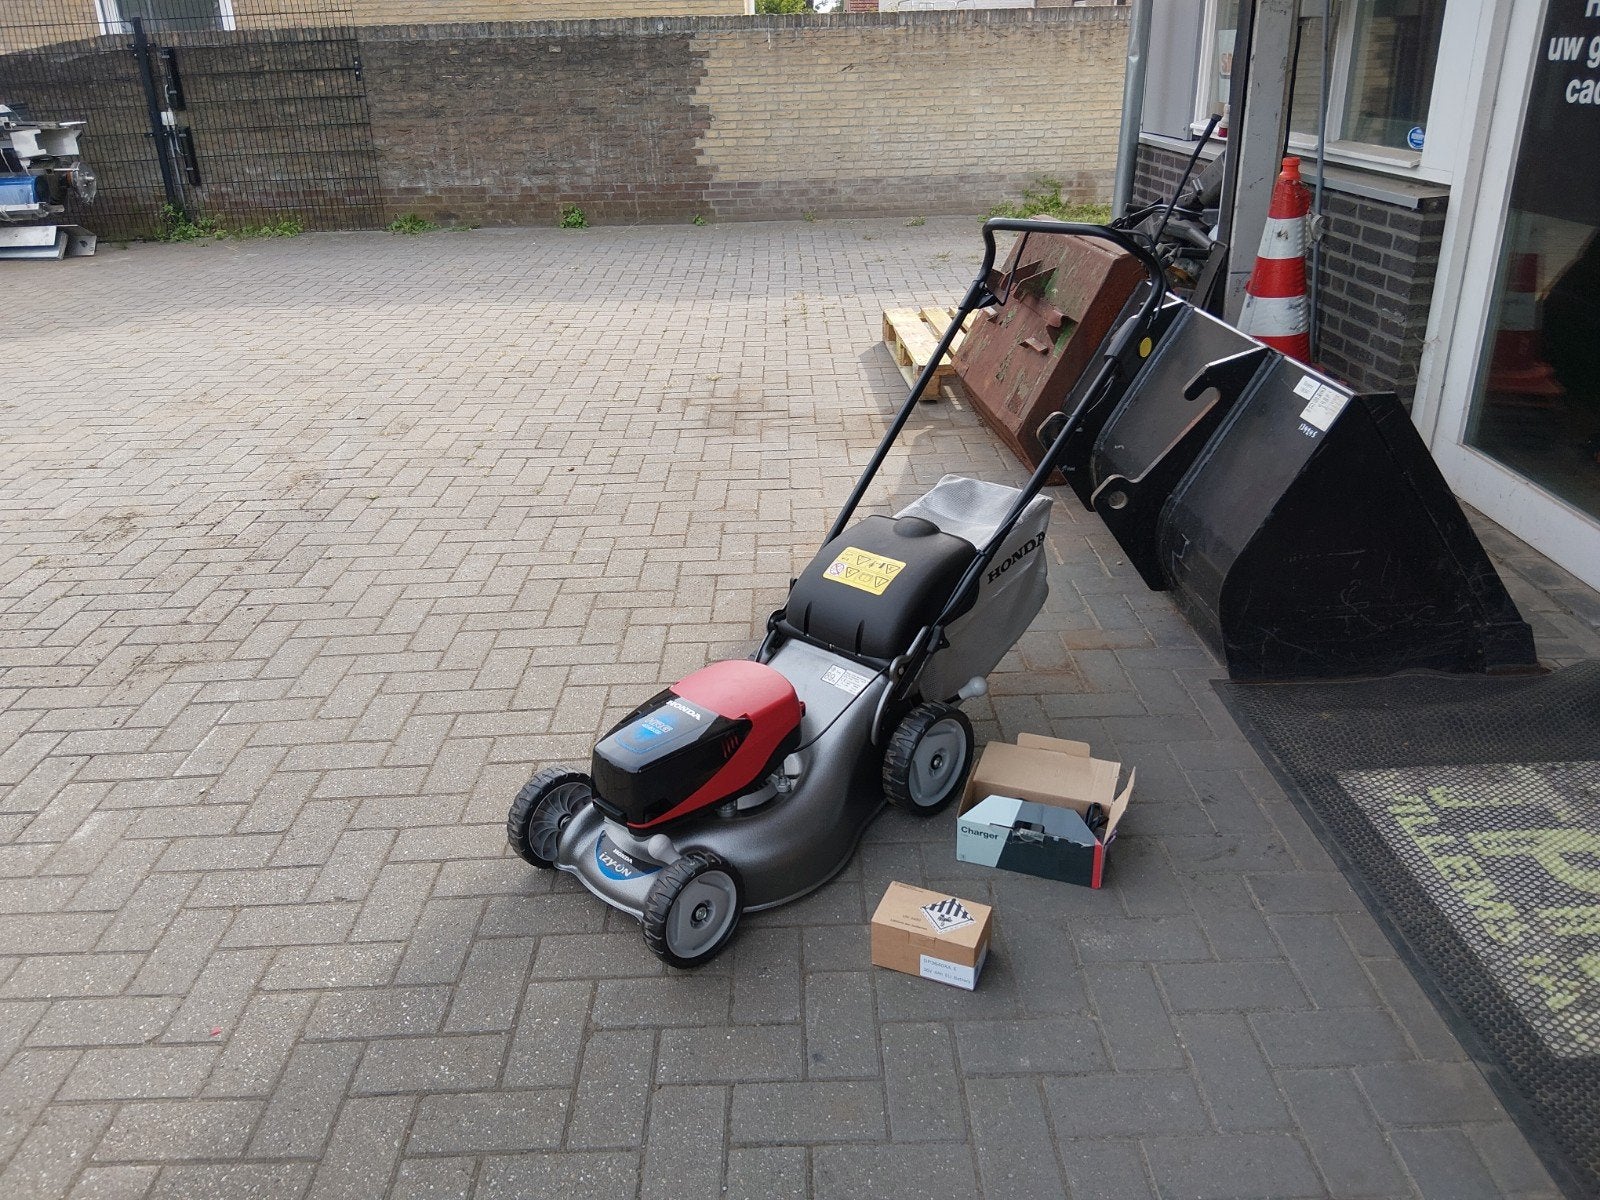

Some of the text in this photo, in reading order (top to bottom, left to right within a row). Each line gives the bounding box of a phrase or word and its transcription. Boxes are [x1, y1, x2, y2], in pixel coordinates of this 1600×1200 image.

[1548, 37, 1585, 61] uw
[986, 531, 1046, 585] HONDA
[666, 700, 701, 721] HONDA
[960, 825, 999, 839] Charger
[612, 848, 633, 864] HONDA
